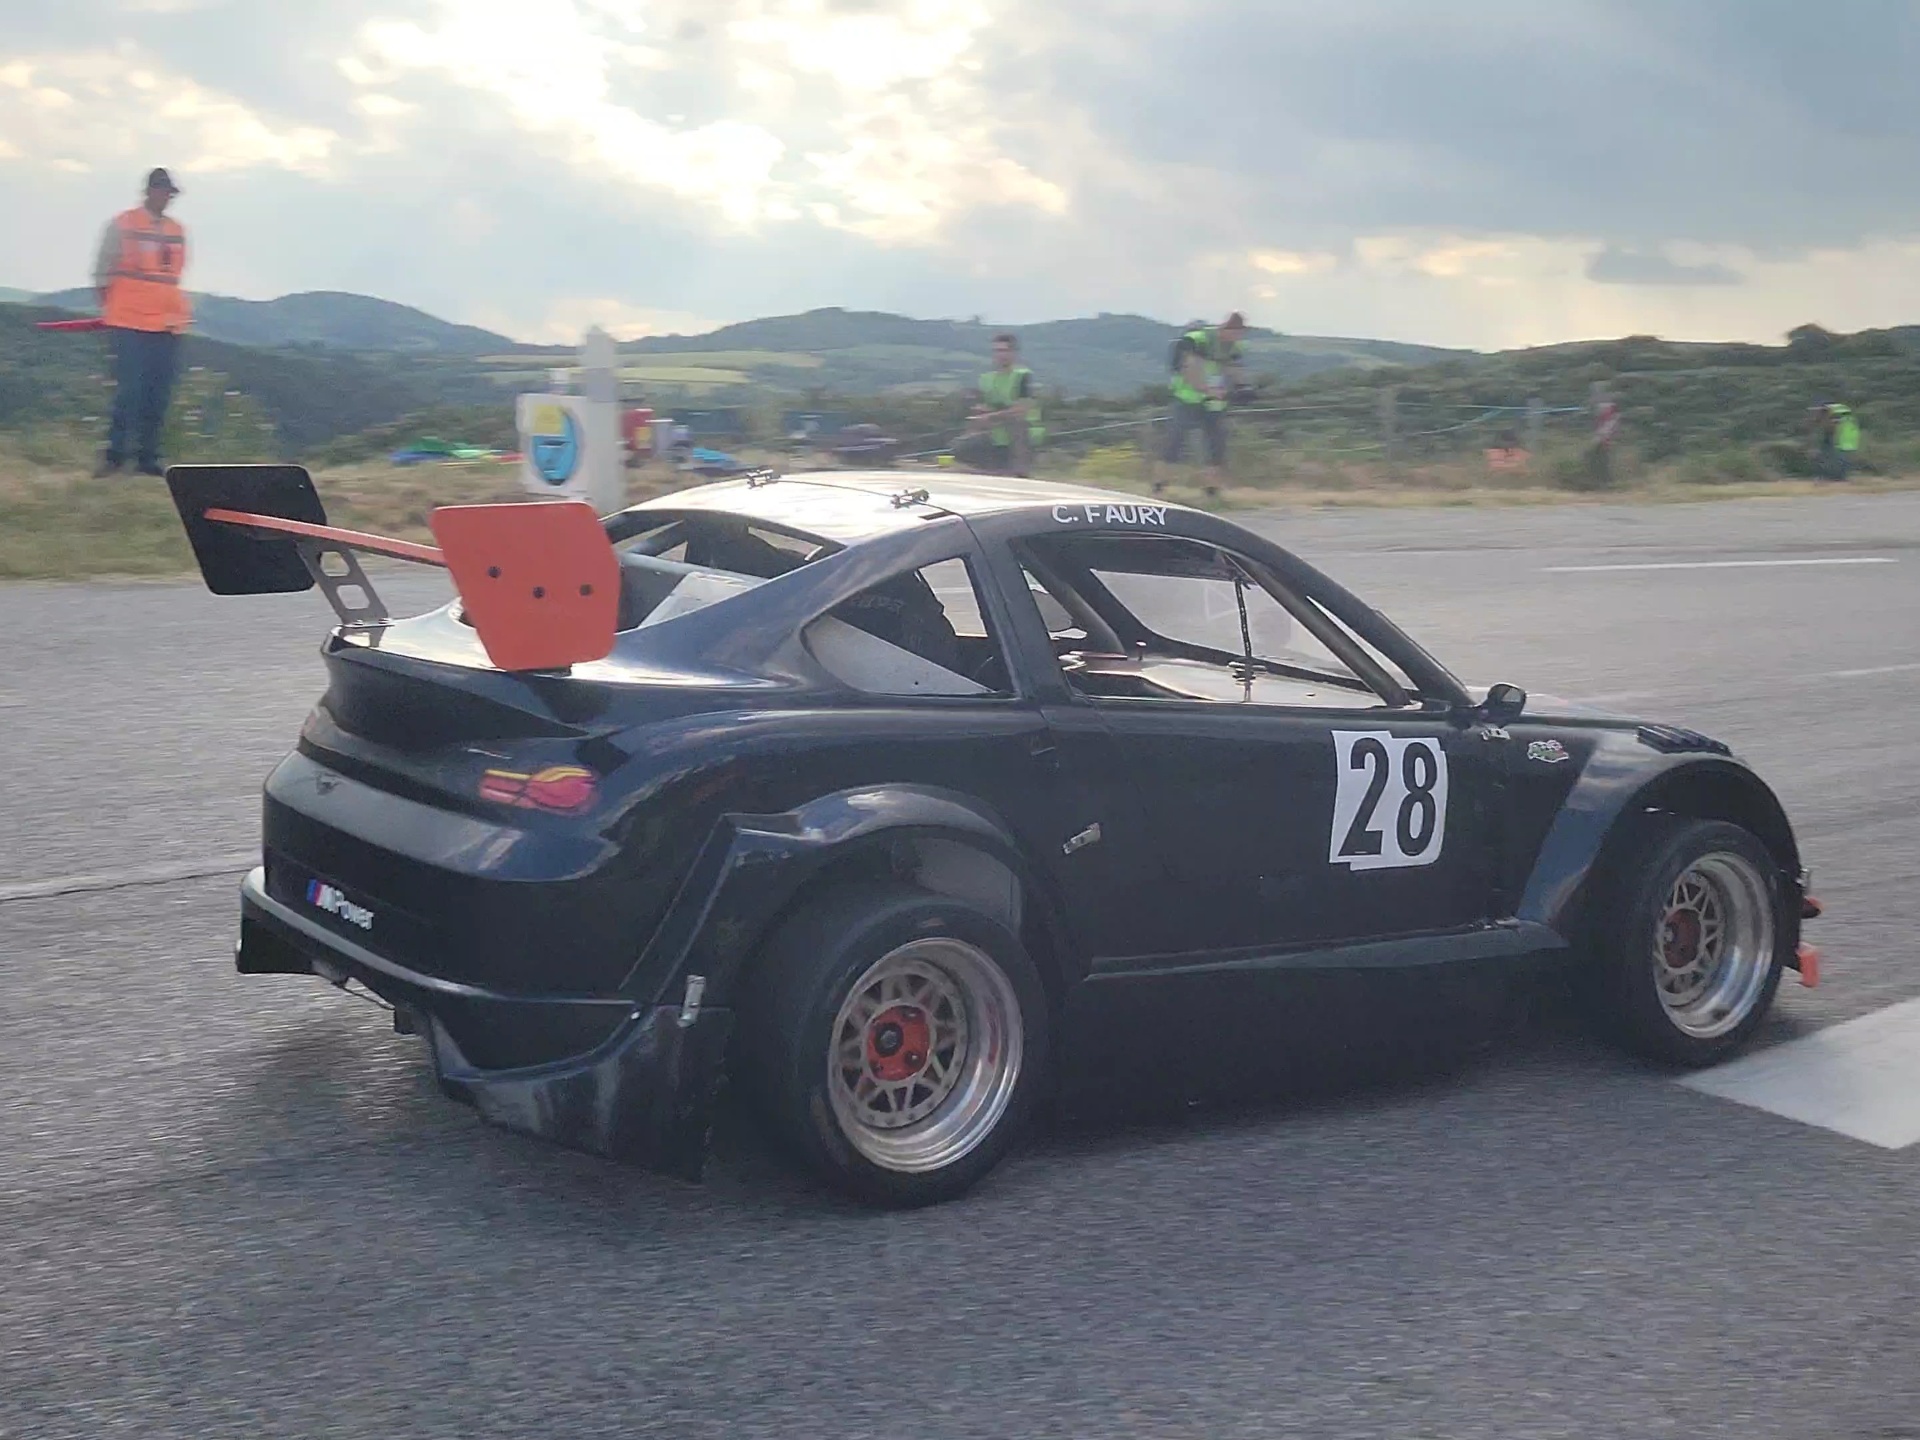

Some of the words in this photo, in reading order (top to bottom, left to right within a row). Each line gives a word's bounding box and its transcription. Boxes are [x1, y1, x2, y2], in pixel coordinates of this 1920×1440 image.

[1052, 504, 1079, 523] C.
[1083, 504, 1167, 526] FAURY
[1338, 737, 1438, 857] 28
